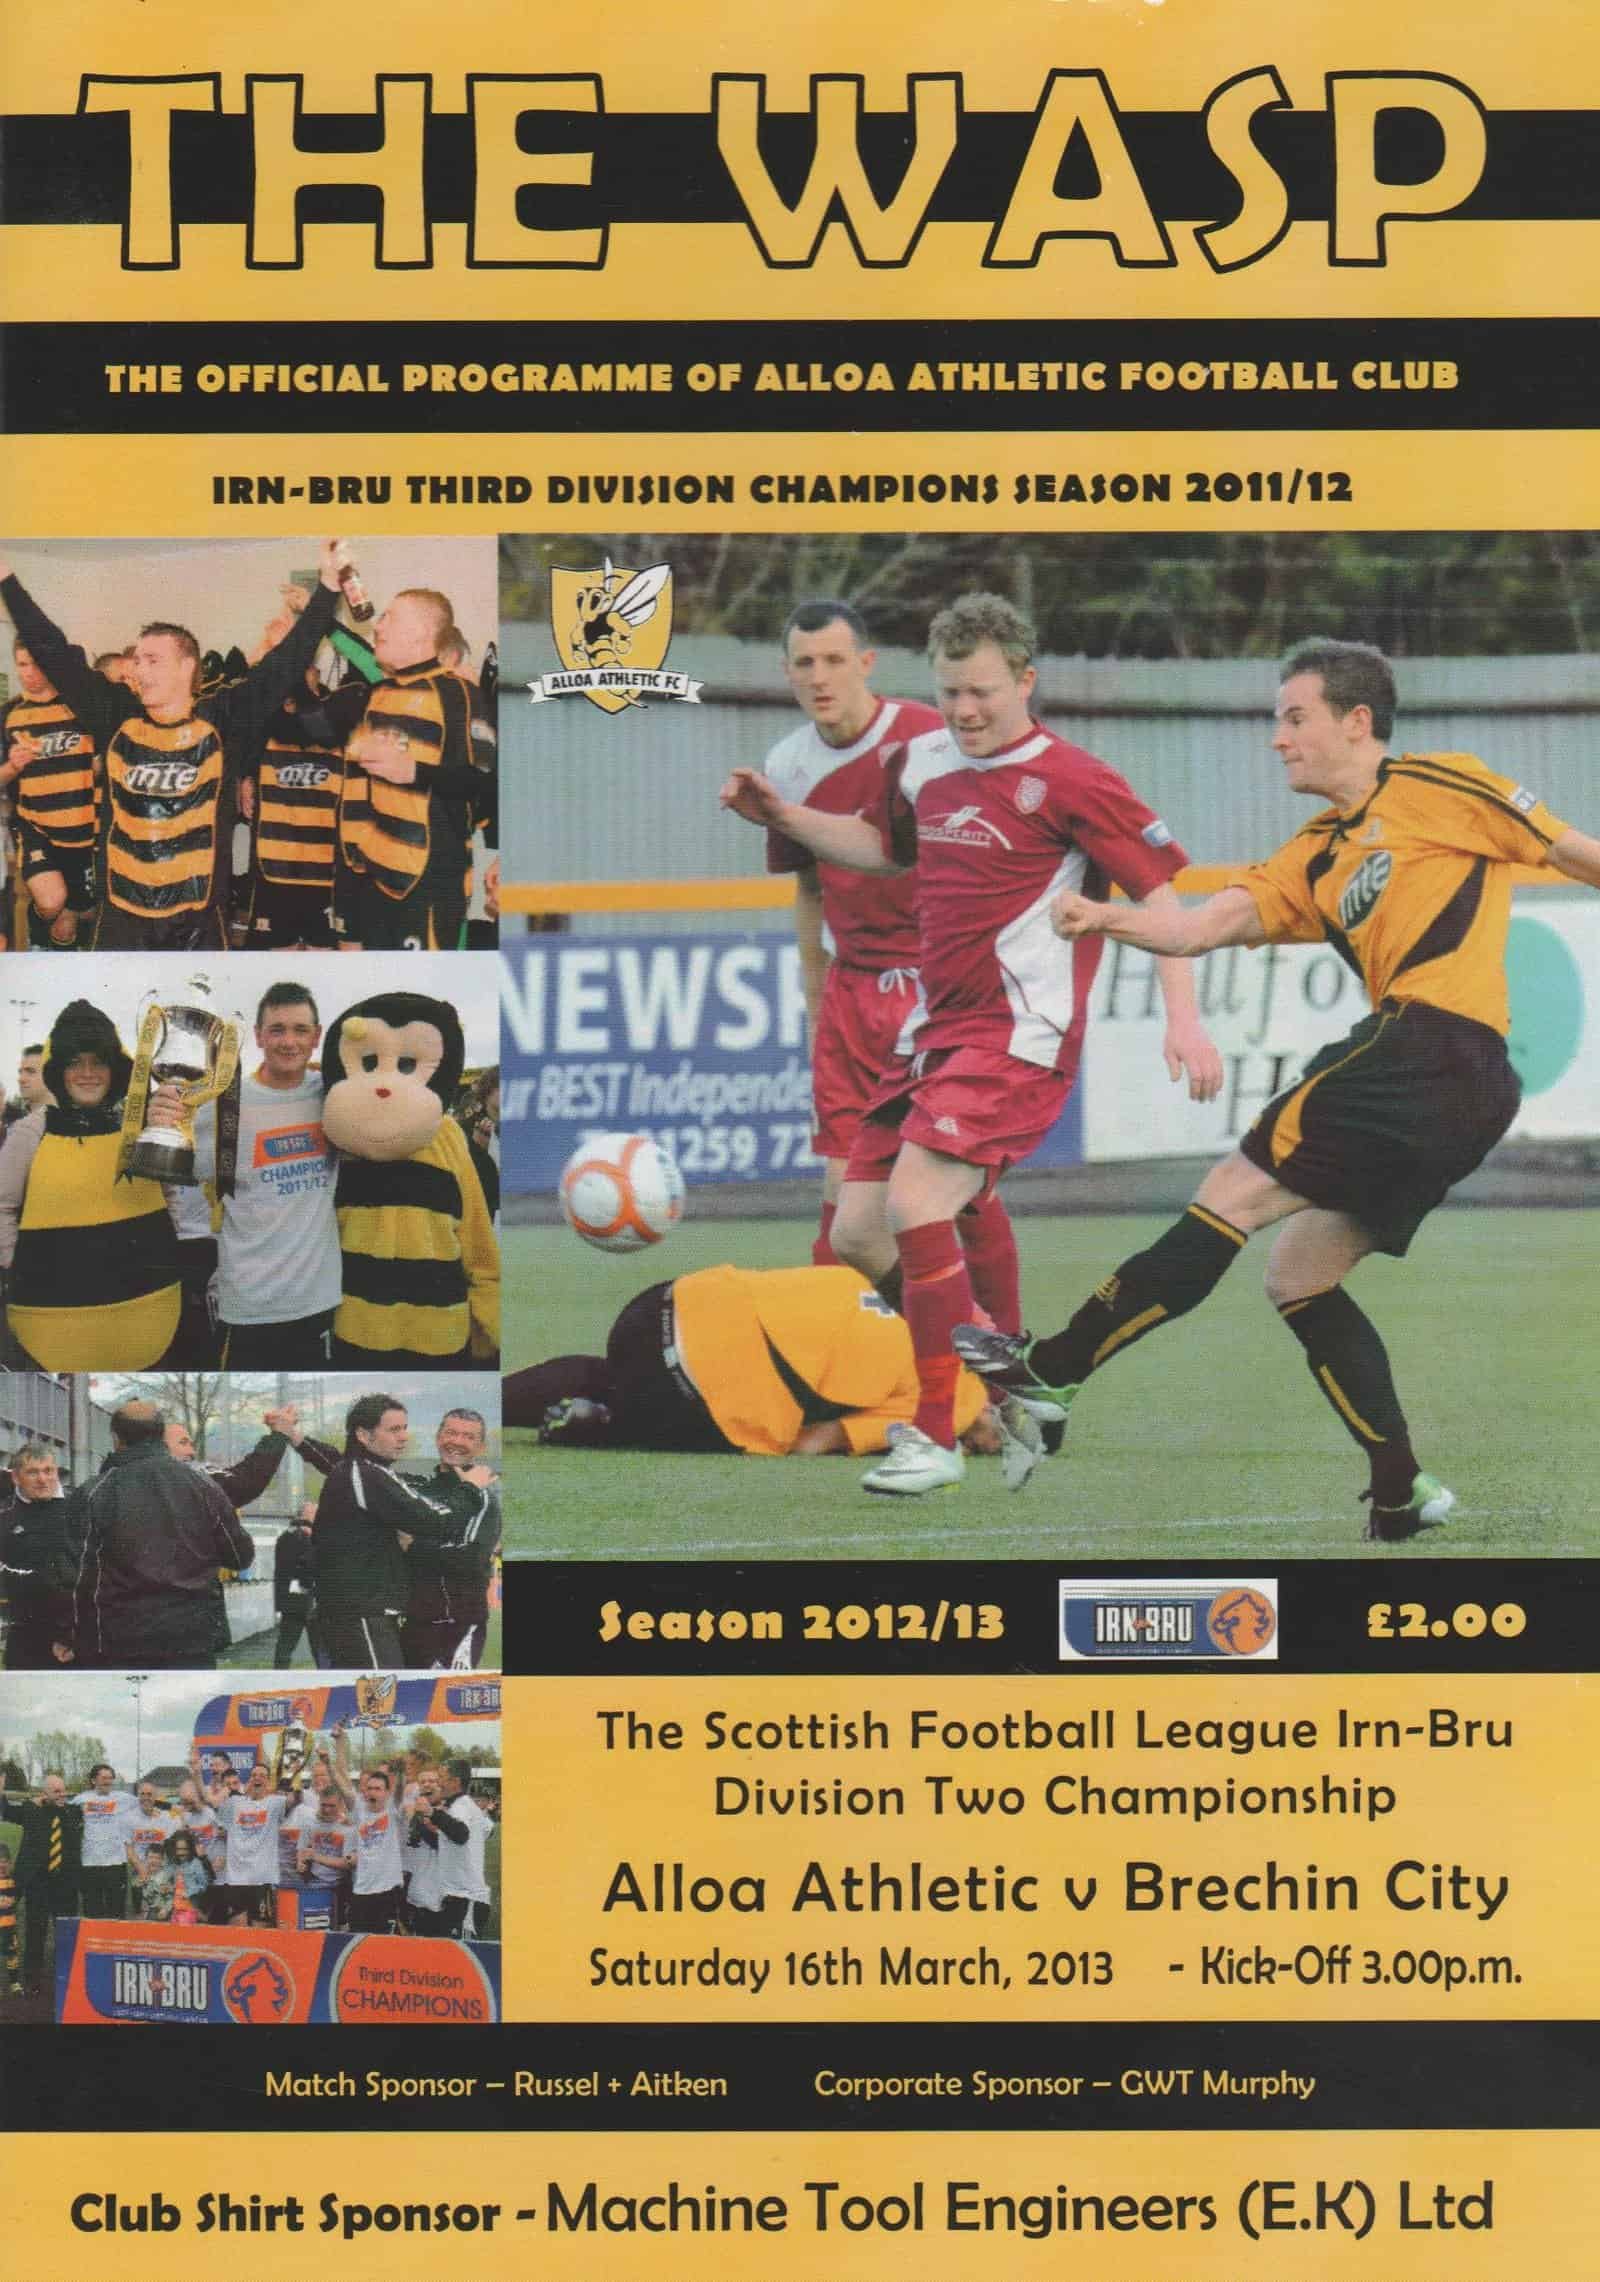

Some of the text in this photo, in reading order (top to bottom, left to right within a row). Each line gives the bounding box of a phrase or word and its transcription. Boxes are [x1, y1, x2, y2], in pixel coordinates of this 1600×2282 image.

[77, 65, 1490, 275] THE WASP
[104, 360, 1459, 393] THE OFFICIAL PROGRAMME OF ALLOA ATHLETIC FOOTBALL CLUB
[212, 468, 1353, 505] IRN-BRU THIRD DIVISION CHAMPIONS SEASON 2011/12
[551, 672, 682, 690] ALLOA ATHLETIC FC
[537, 1062, 629, 1121] BEST
[598, 1599, 1004, 1643] Season 2012/13
[1367, 1602, 1527, 1638] £2.00
[596, 1708, 1512, 1755] The Scottish Football League Irn-Bru
[715, 1774, 1396, 1822] Division Two Championship
[602, 1859, 1509, 1921] Alloa Athletic v Brechin City
[590, 1946, 770, 1994] Saturday
[785, 1946, 862, 1986] 16th
[880, 1946, 1011, 1990] March,
[1027, 1951, 1113, 1986] 2013
[1201, 1944, 1352, 1985] Kick-Off
[1362, 1950, 1522, 1993] 3.00p.m.
[342, 1988, 484, 2020] CHAMPIONS
[266, 2071, 356, 2097] Match
[366, 2071, 477, 2101] Sponsor
[515, 2070, 599, 2097] Russel
[630, 2070, 727, 2096] Aitken
[814, 2070, 963, 2101] Corporate
[972, 2070, 1084, 2101] Sponsor
[1120, 2069, 1194, 2095] GWT
[1203, 2069, 1316, 2100] Murphy
[70, 2192, 181, 2233] Club
[196, 2192, 305, 2233] Shirt
[319, 2192, 501, 2240] Sponsor
[547, 2181, 788, 2233] Machine
[804, 2181, 924, 2232] Tool
[947, 2181, 1217, 2240] Engineers
[1238, 2179, 1376, 2241] (E.K)
[1399, 2180, 1493, 2230] Ltd
